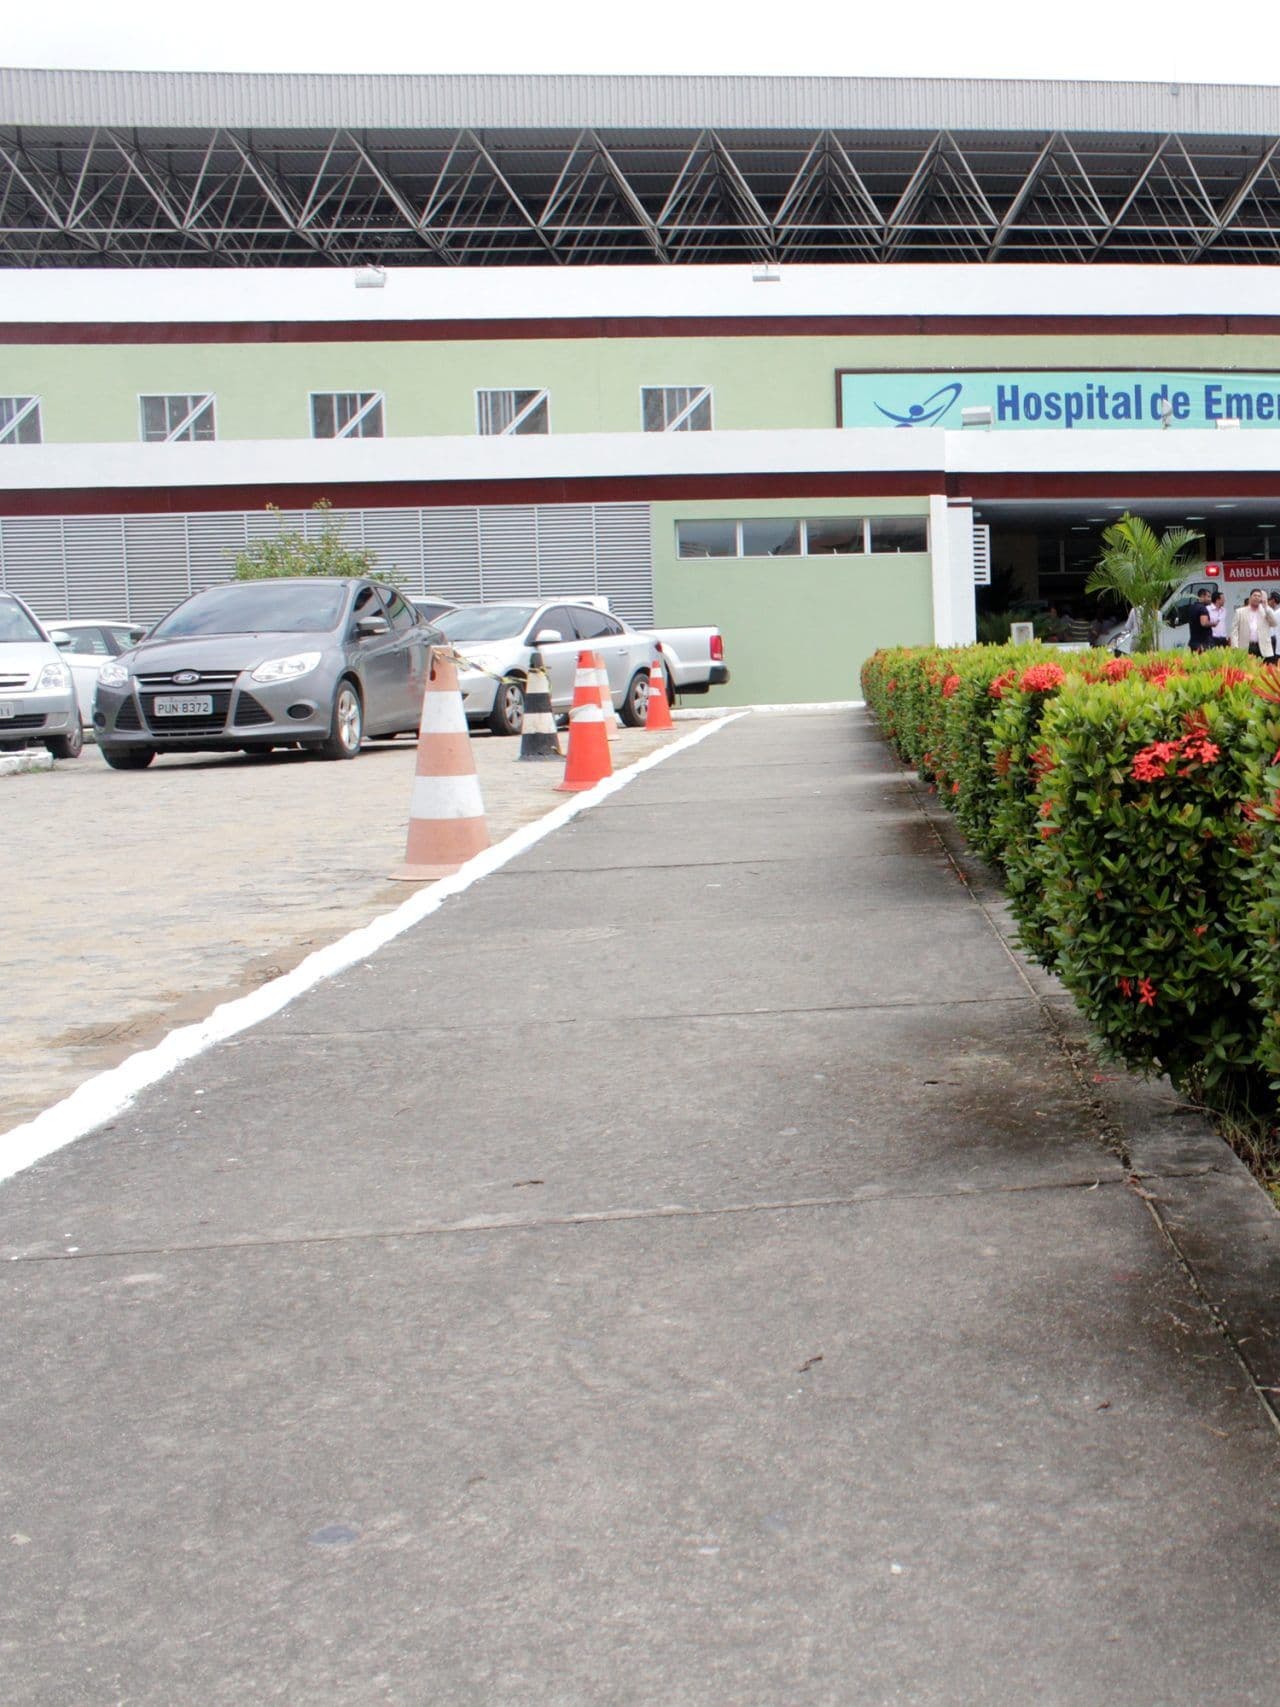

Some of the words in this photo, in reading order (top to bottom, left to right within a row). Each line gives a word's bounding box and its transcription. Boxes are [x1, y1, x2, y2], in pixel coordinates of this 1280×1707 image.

[996, 383, 1142, 428] Hospital
[1150, 384, 1190, 421] de
[158, 703, 178, 713] PUN
[182, 702, 209, 713] 8372
